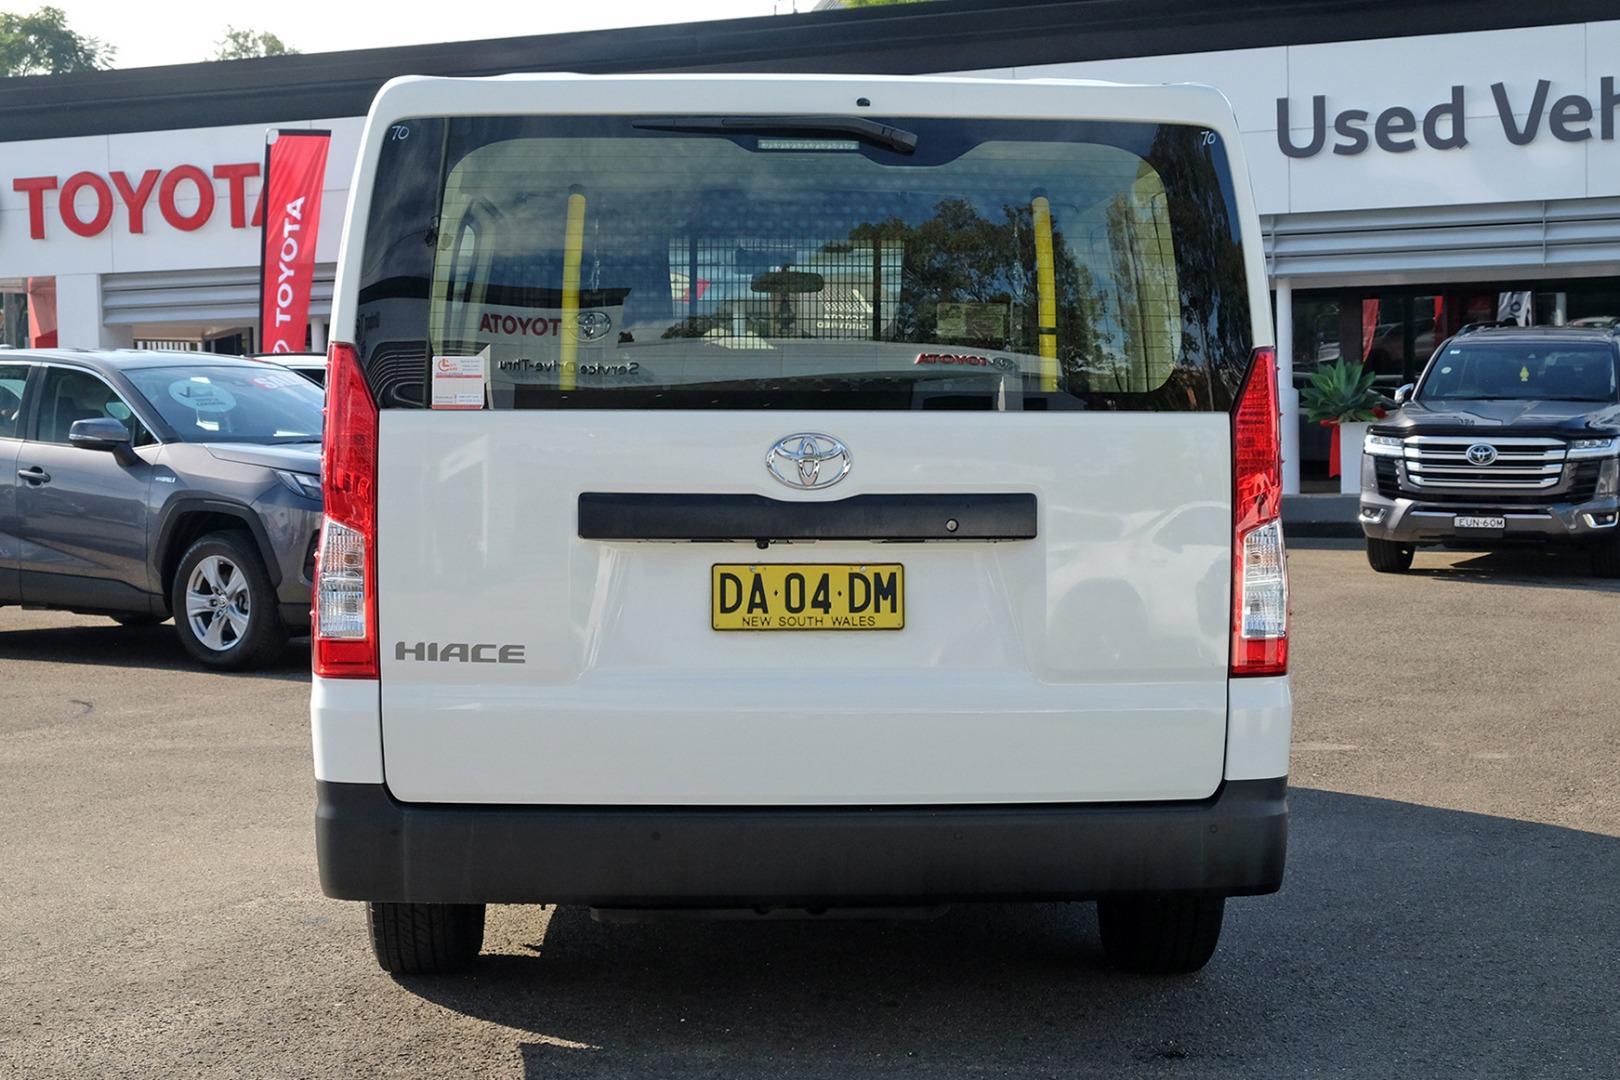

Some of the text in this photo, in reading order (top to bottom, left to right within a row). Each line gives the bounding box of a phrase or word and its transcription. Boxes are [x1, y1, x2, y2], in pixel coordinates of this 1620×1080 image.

[1276, 85, 1469, 158] Used
[13, 162, 266, 240] TOYOT
[275, 196, 305, 328] TOYOTA
[395, 641, 526, 664] HIACE
[742, 616, 876, 627] NEW SOUTH WALES
